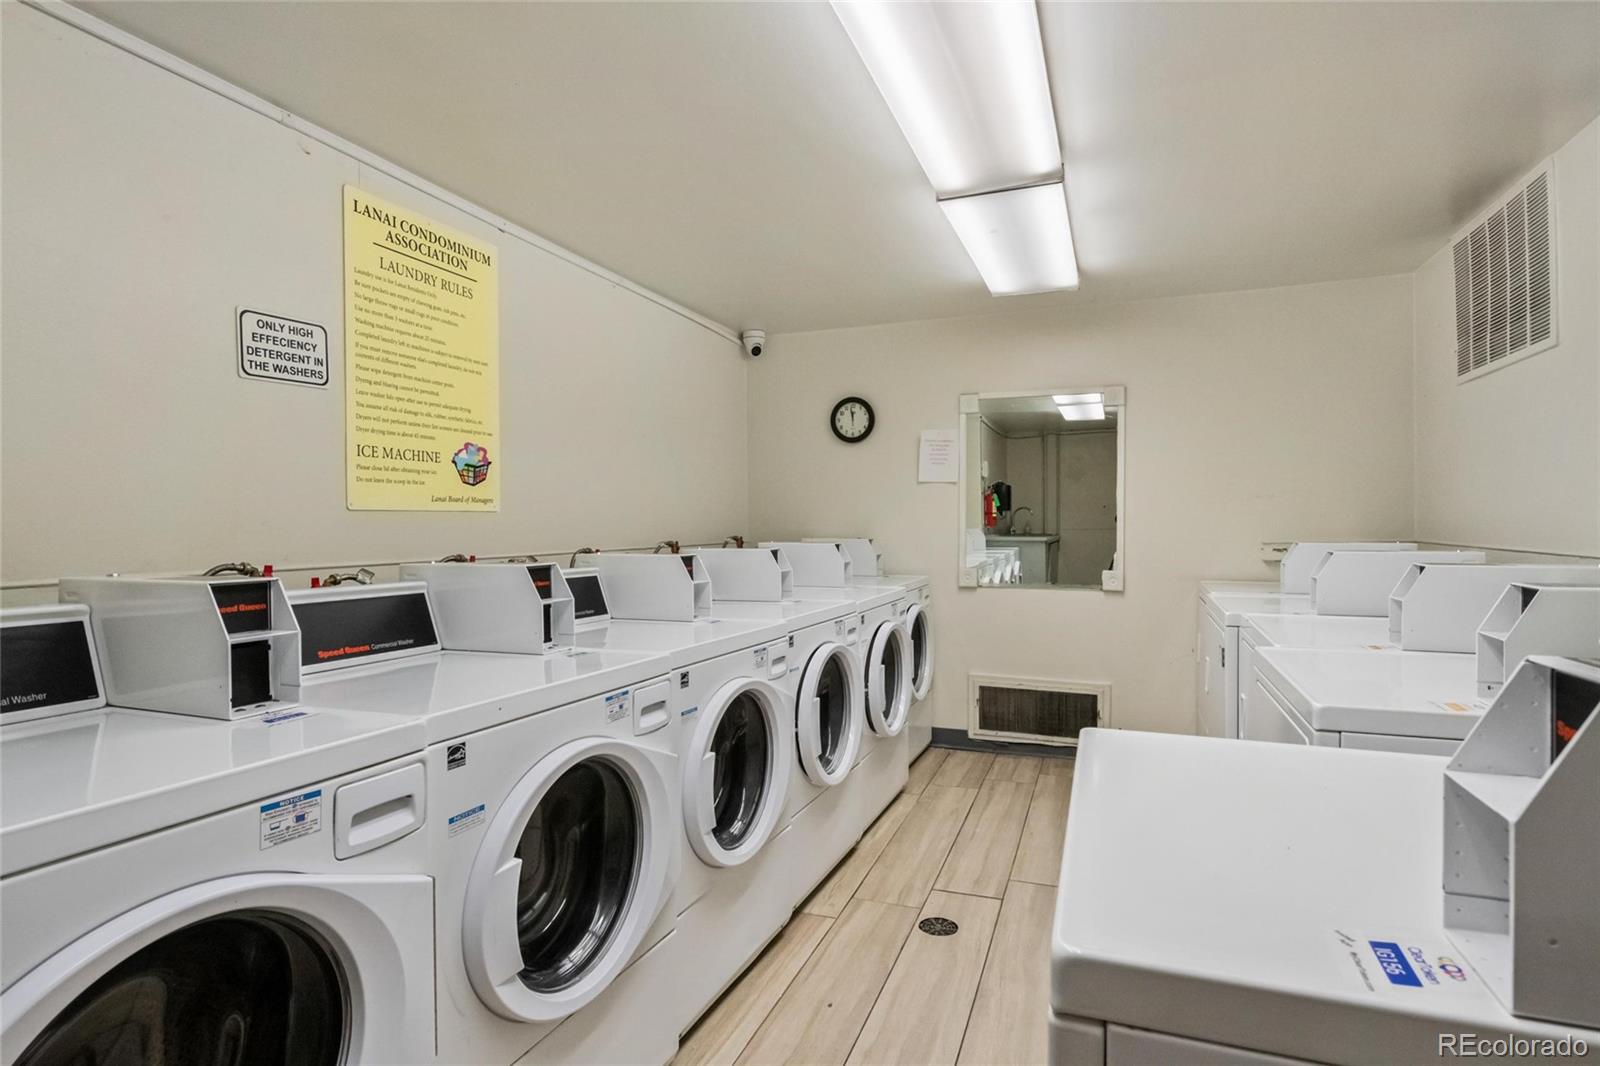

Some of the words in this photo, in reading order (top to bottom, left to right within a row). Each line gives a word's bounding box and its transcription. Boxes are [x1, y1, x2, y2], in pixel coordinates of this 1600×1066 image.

[353, 199, 397, 228] LANAI
[400, 219, 491, 266] CONDOMINIUM
[385, 230, 468, 271] ASSOCIATION
[379, 256, 438, 287] LAUNDRY
[441, 278, 473, 300] RULES
[256, 319, 285, 333] ONLY
[288, 325, 314, 339] HIGH
[251, 332, 318, 353] EFFECIENCY
[246, 345, 312, 365] DETERGENT
[314, 357, 324, 367] IN
[247, 359, 270, 372] THE
[272, 363, 324, 380] WASHERS
[356, 444, 379, 458] ICE
[382, 447, 441, 464] MACHINE
[431, 495, 447, 503] Lanai
[448, 495, 464, 503] Board
[464, 495, 471, 505] of
[471, 496, 494, 505] Managers
[239, 603, 267, 611] Queen
[318, 647, 344, 660] Speed
[344, 645, 370, 654] Queen
[370, 641, 398, 650] Commercial
[11, 693, 47, 704] Washer
[279, 795, 305, 807] NOTICE
[1374, 947, 1407, 975] IG156
